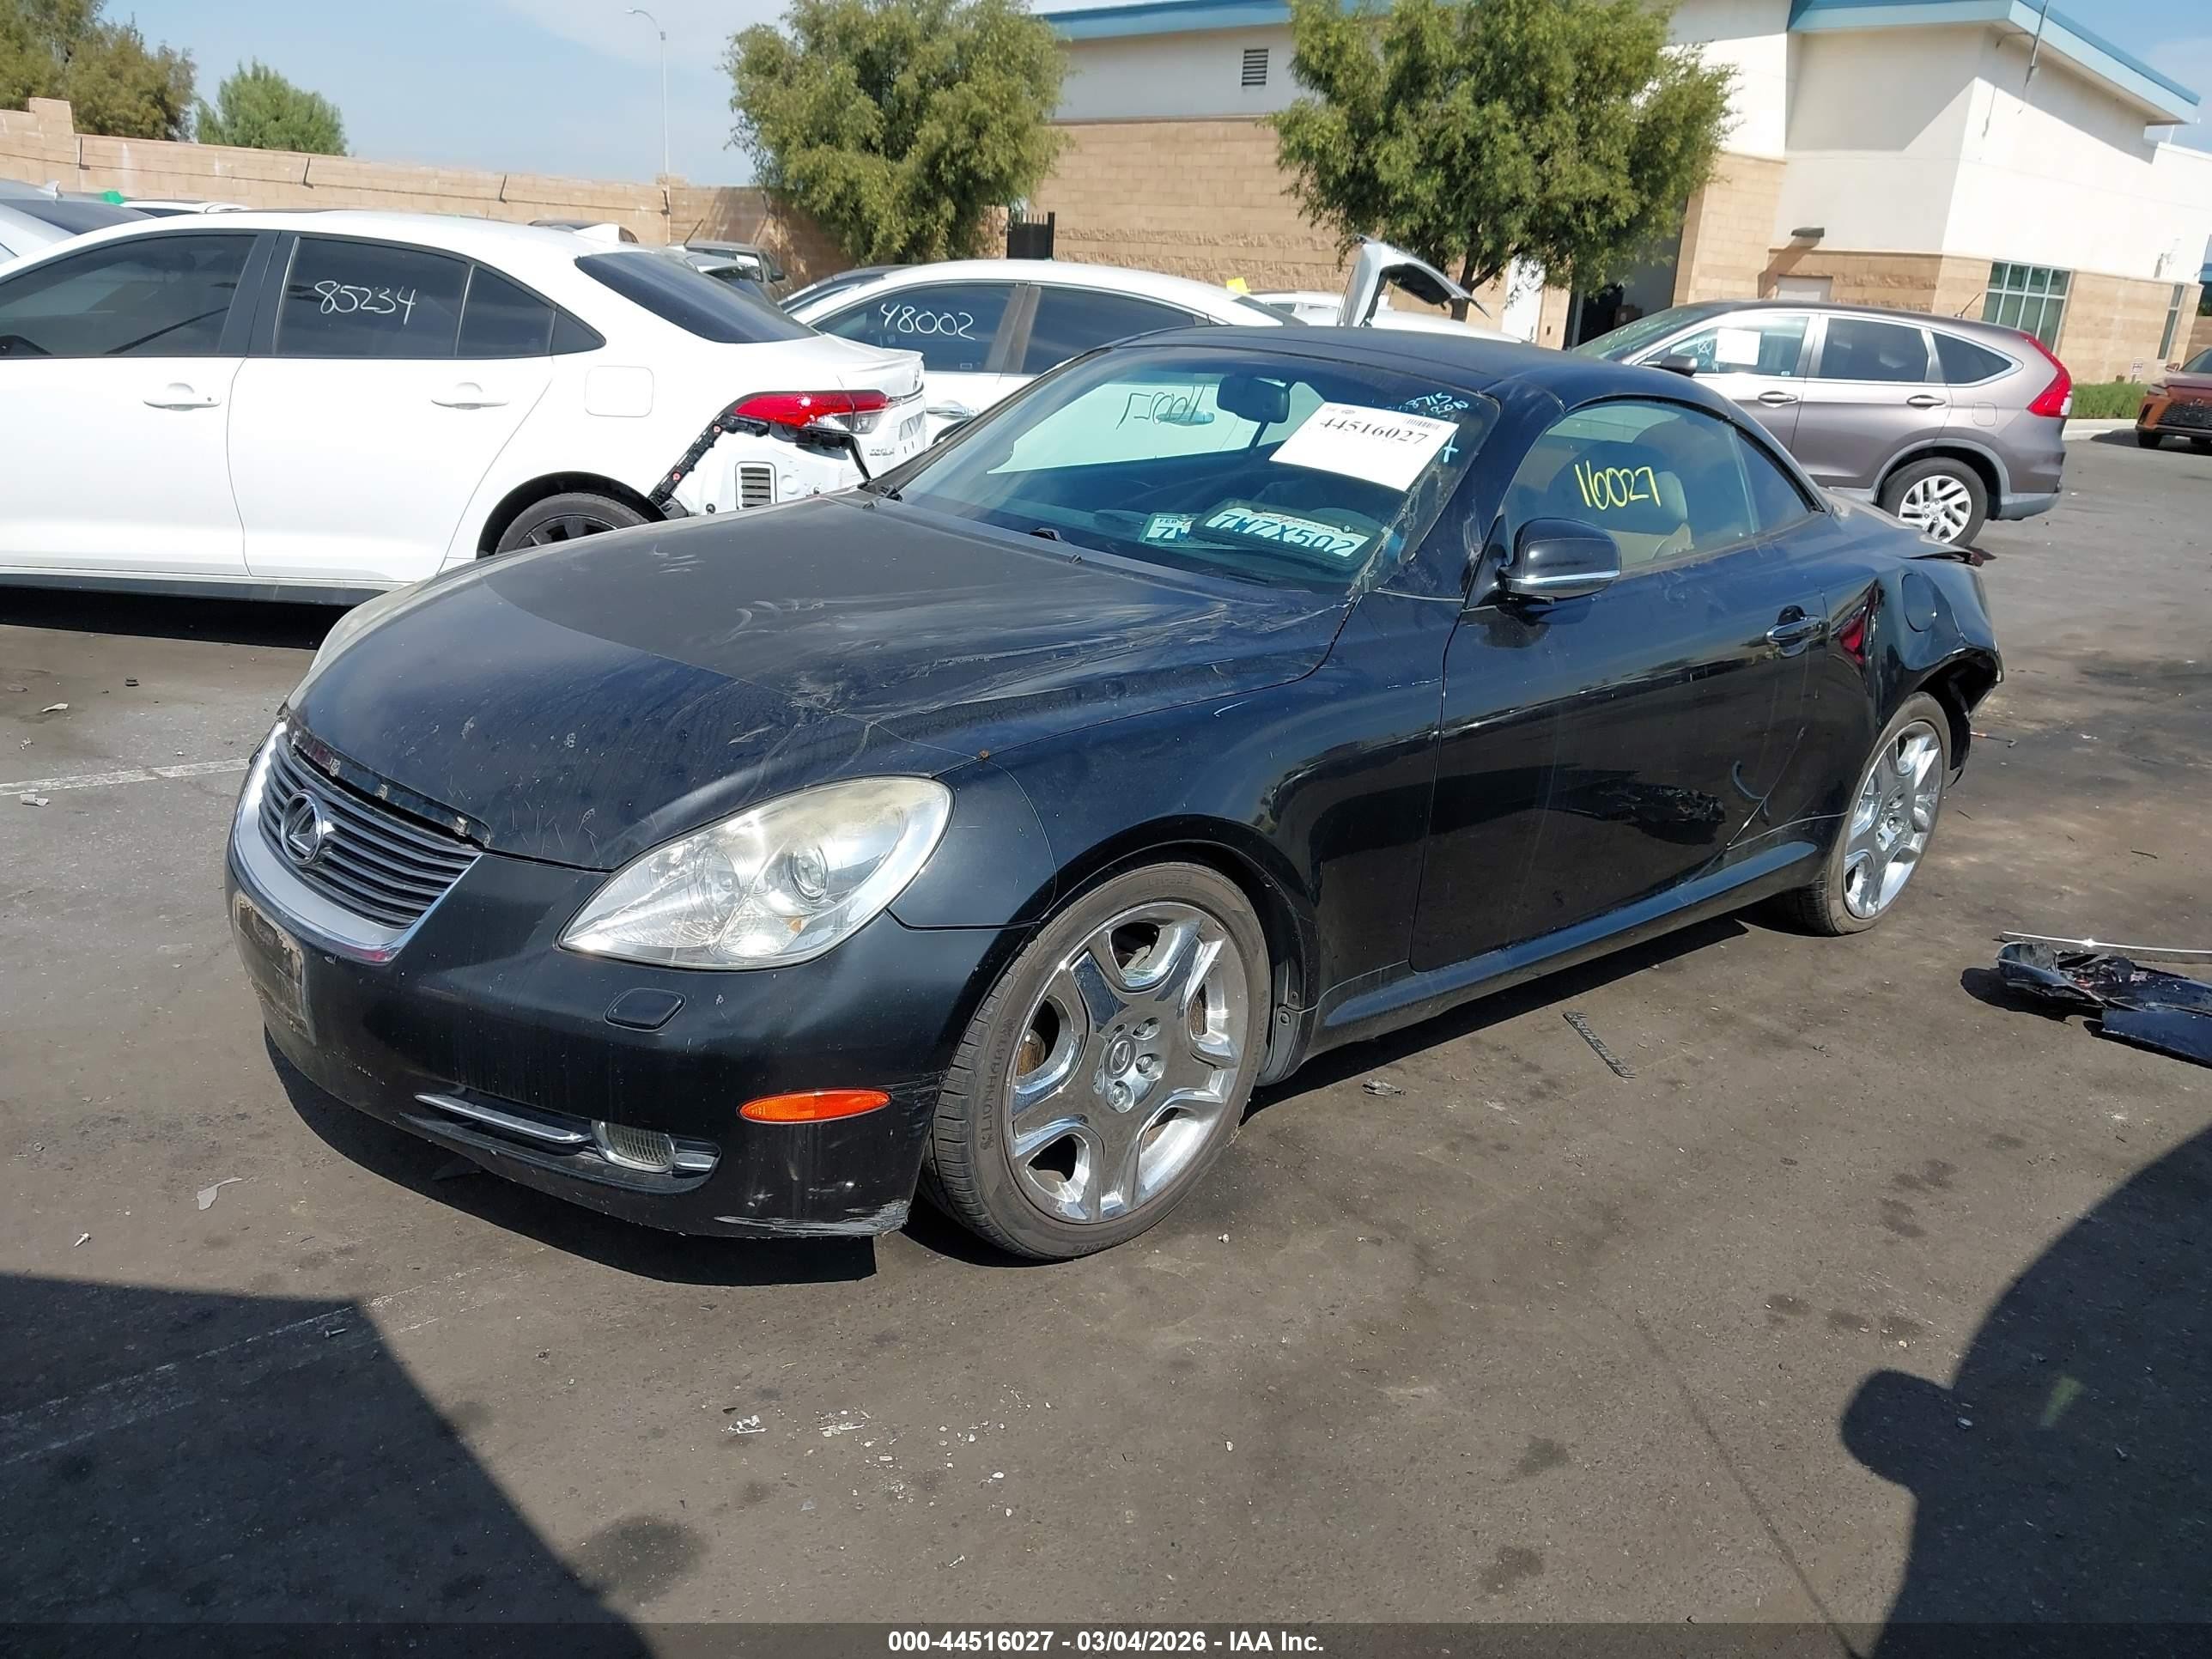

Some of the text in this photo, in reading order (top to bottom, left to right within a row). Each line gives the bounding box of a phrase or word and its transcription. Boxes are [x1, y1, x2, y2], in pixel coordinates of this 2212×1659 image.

[314, 280, 416, 325] 85234
[880, 303, 975, 340] 48002
[1320, 417, 1429, 445] 44516027
[1575, 459, 1662, 510] 16027
